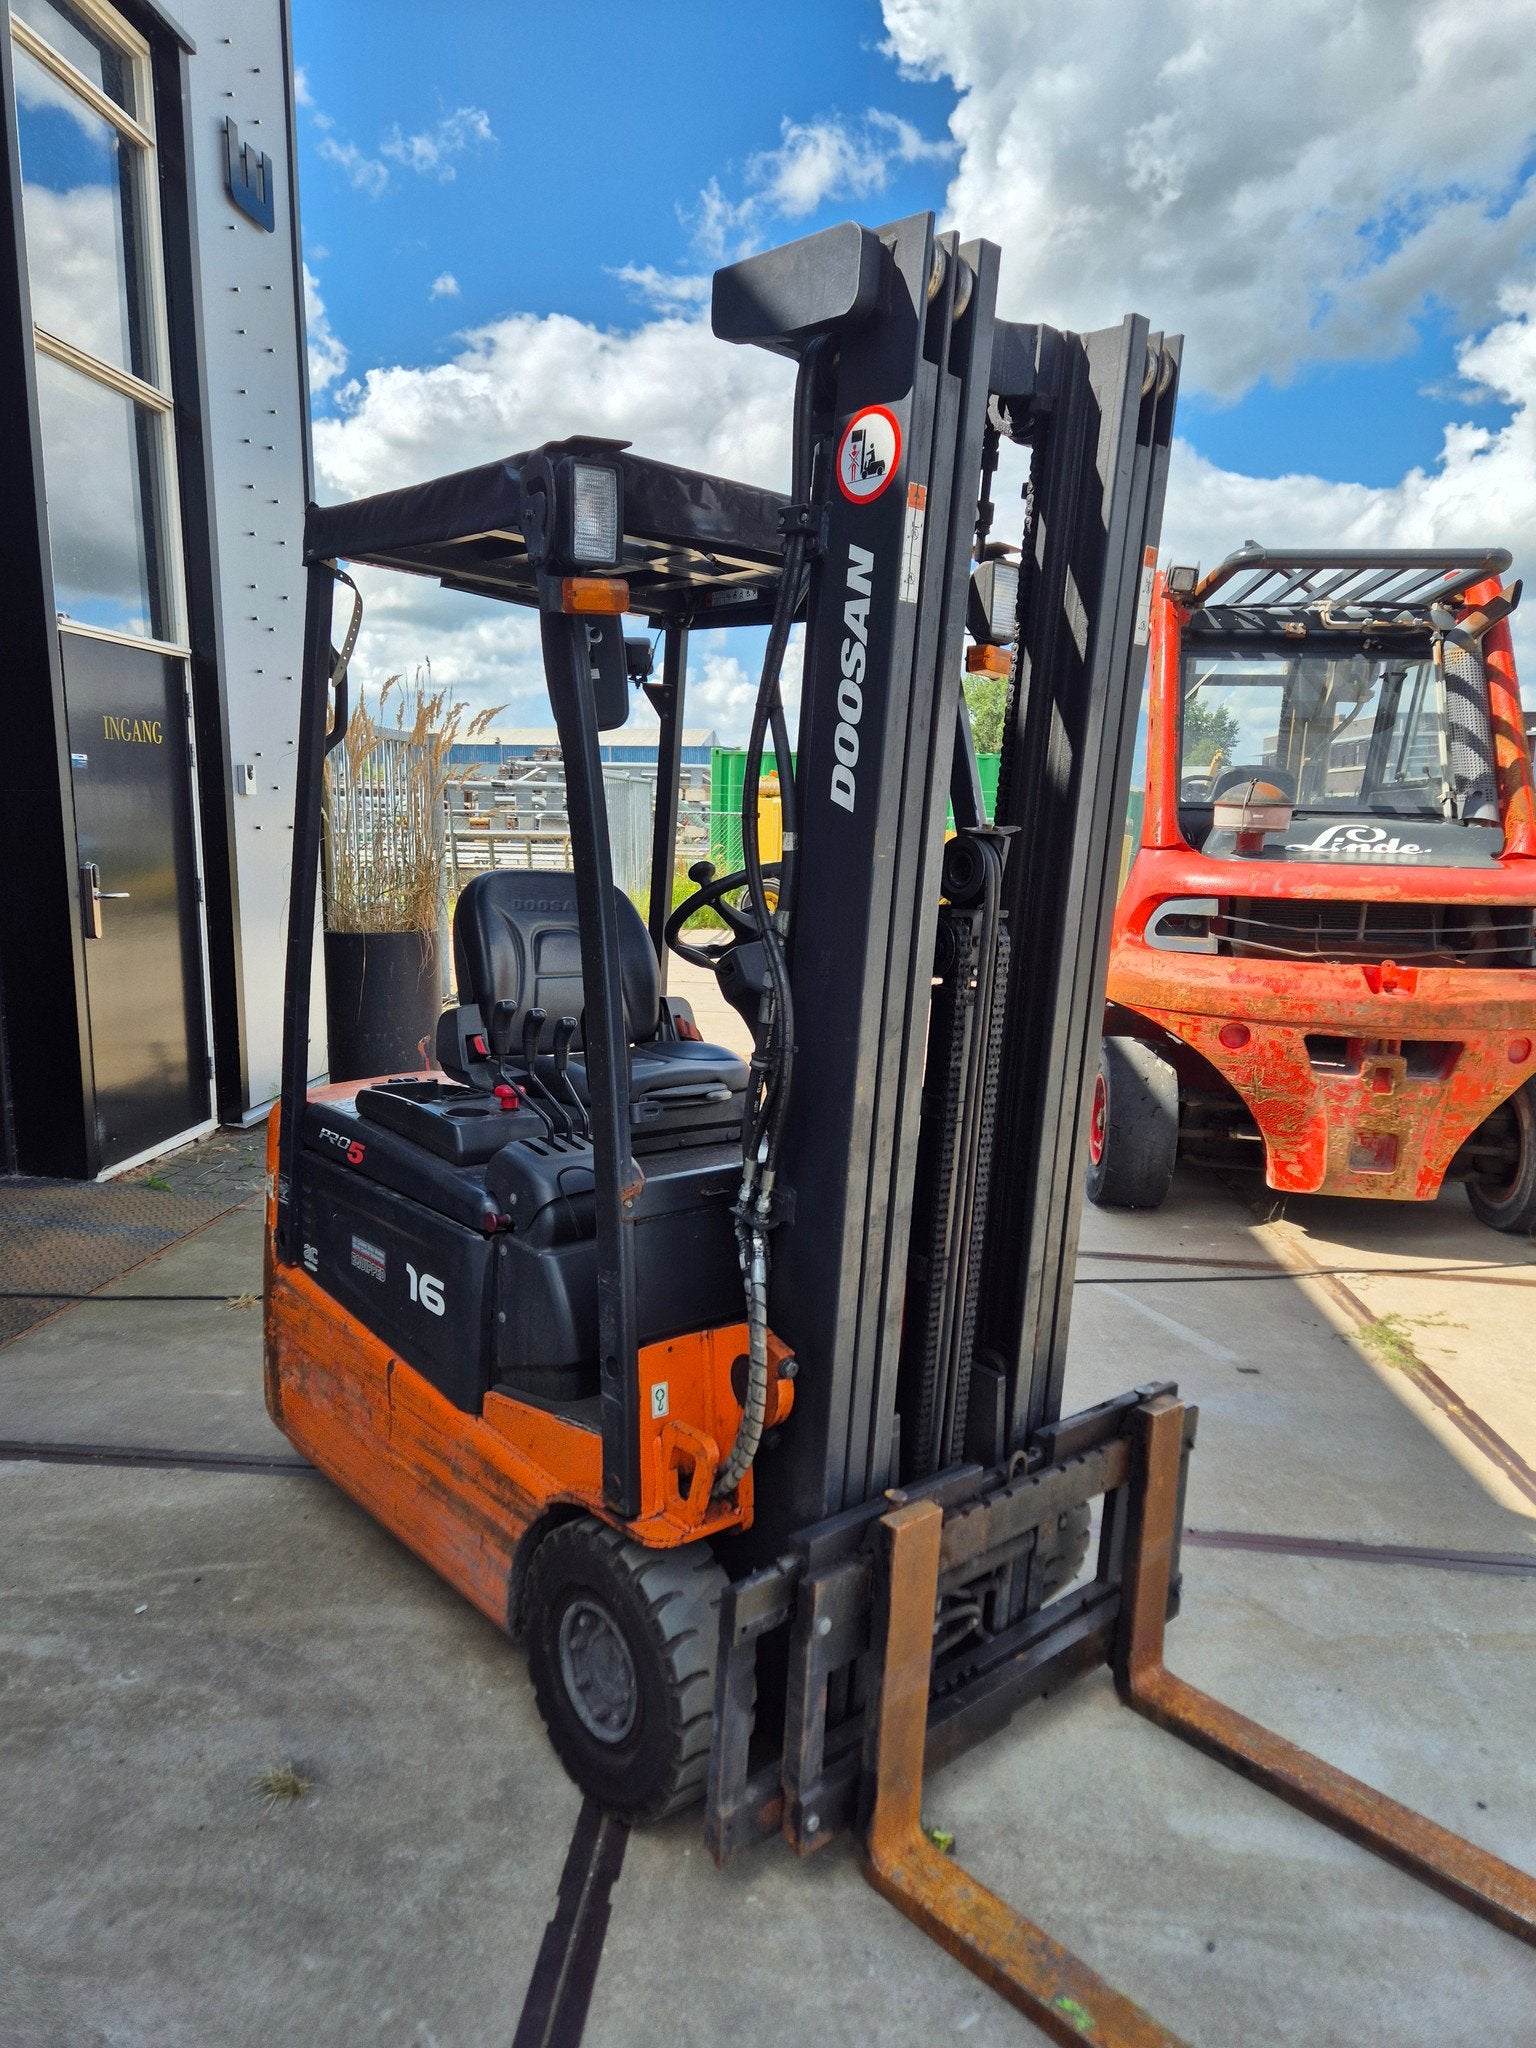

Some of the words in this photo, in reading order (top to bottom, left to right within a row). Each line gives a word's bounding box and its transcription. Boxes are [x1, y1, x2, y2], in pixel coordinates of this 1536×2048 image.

[830, 543, 874, 813] DOOSAN
[102, 715, 164, 744] INGANG
[1285, 824, 1432, 854] Linde
[405, 1262, 446, 1317] 16
